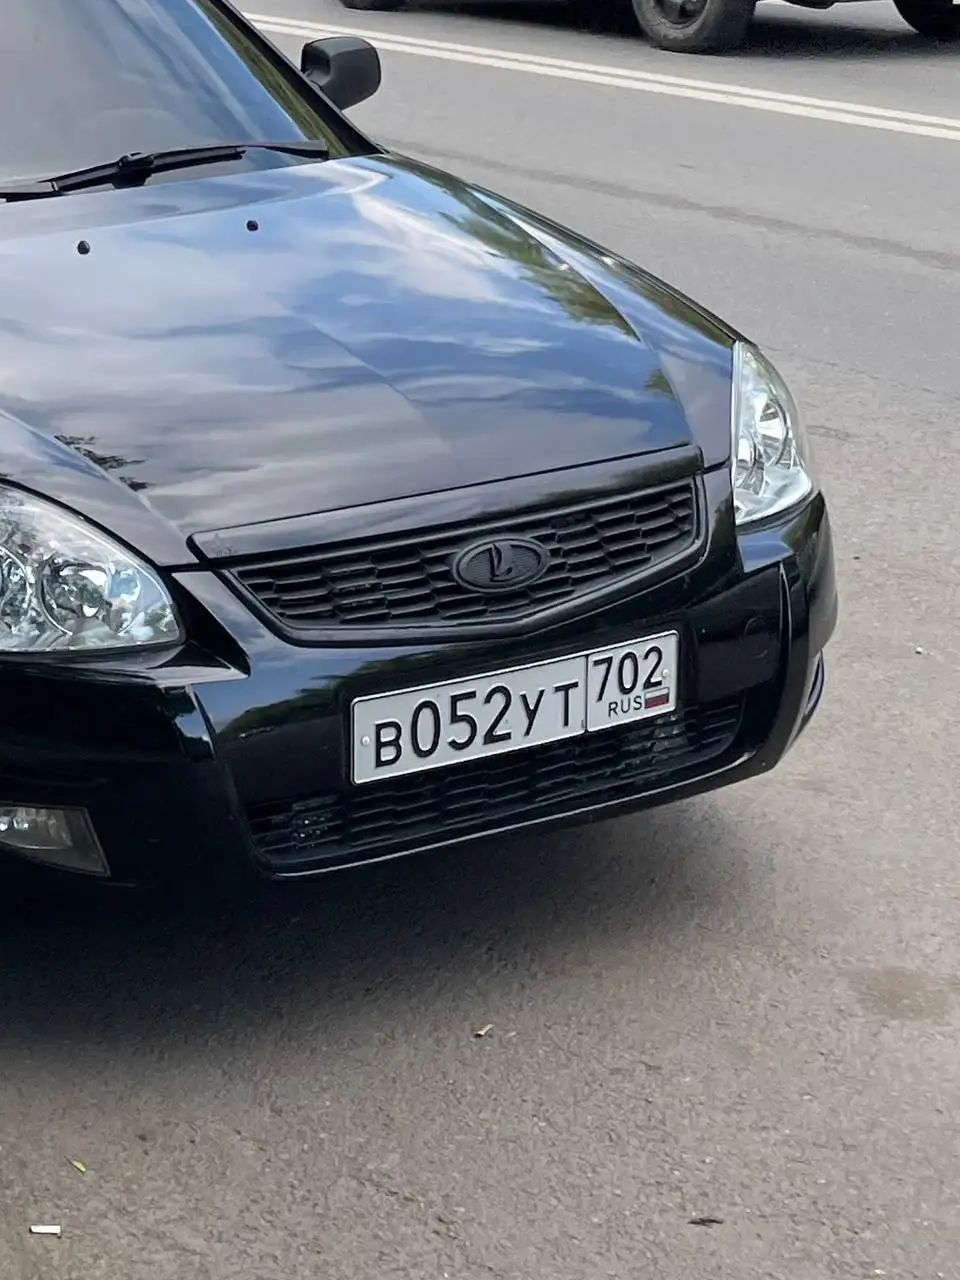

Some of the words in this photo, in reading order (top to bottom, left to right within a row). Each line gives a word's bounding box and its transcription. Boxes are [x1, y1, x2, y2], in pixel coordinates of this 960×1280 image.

[374, 681, 580, 769] В052УТ
[592, 645, 664, 703] 702
[608, 695, 643, 718] RUS
